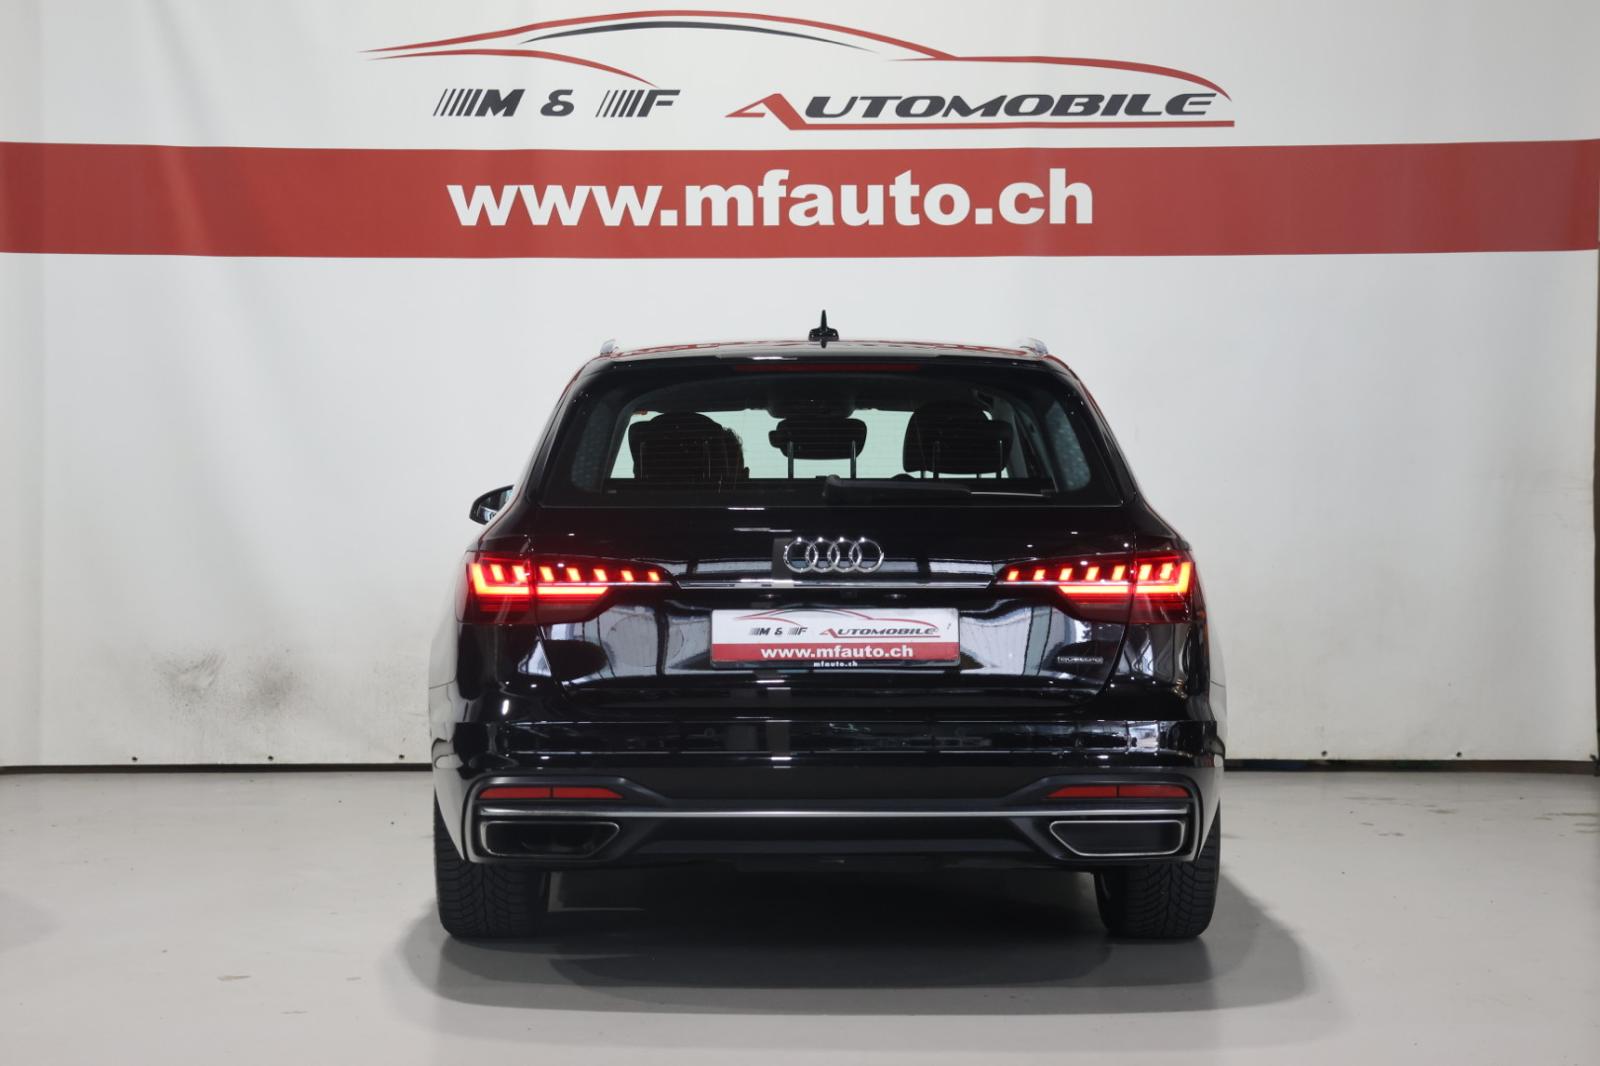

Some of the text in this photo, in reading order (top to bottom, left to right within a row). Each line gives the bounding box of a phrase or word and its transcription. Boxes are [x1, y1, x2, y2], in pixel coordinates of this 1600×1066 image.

[433, 88, 1217, 130] M & F AUTOMOBILE
[446, 167, 1094, 228] www.mfauto.ch
[774, 627, 783, 636] &
[819, 628, 937, 638] AUTOMOBILE
[760, 645, 914, 659] www.mfauto.ch
[813, 660, 859, 668] mfauto.ch
